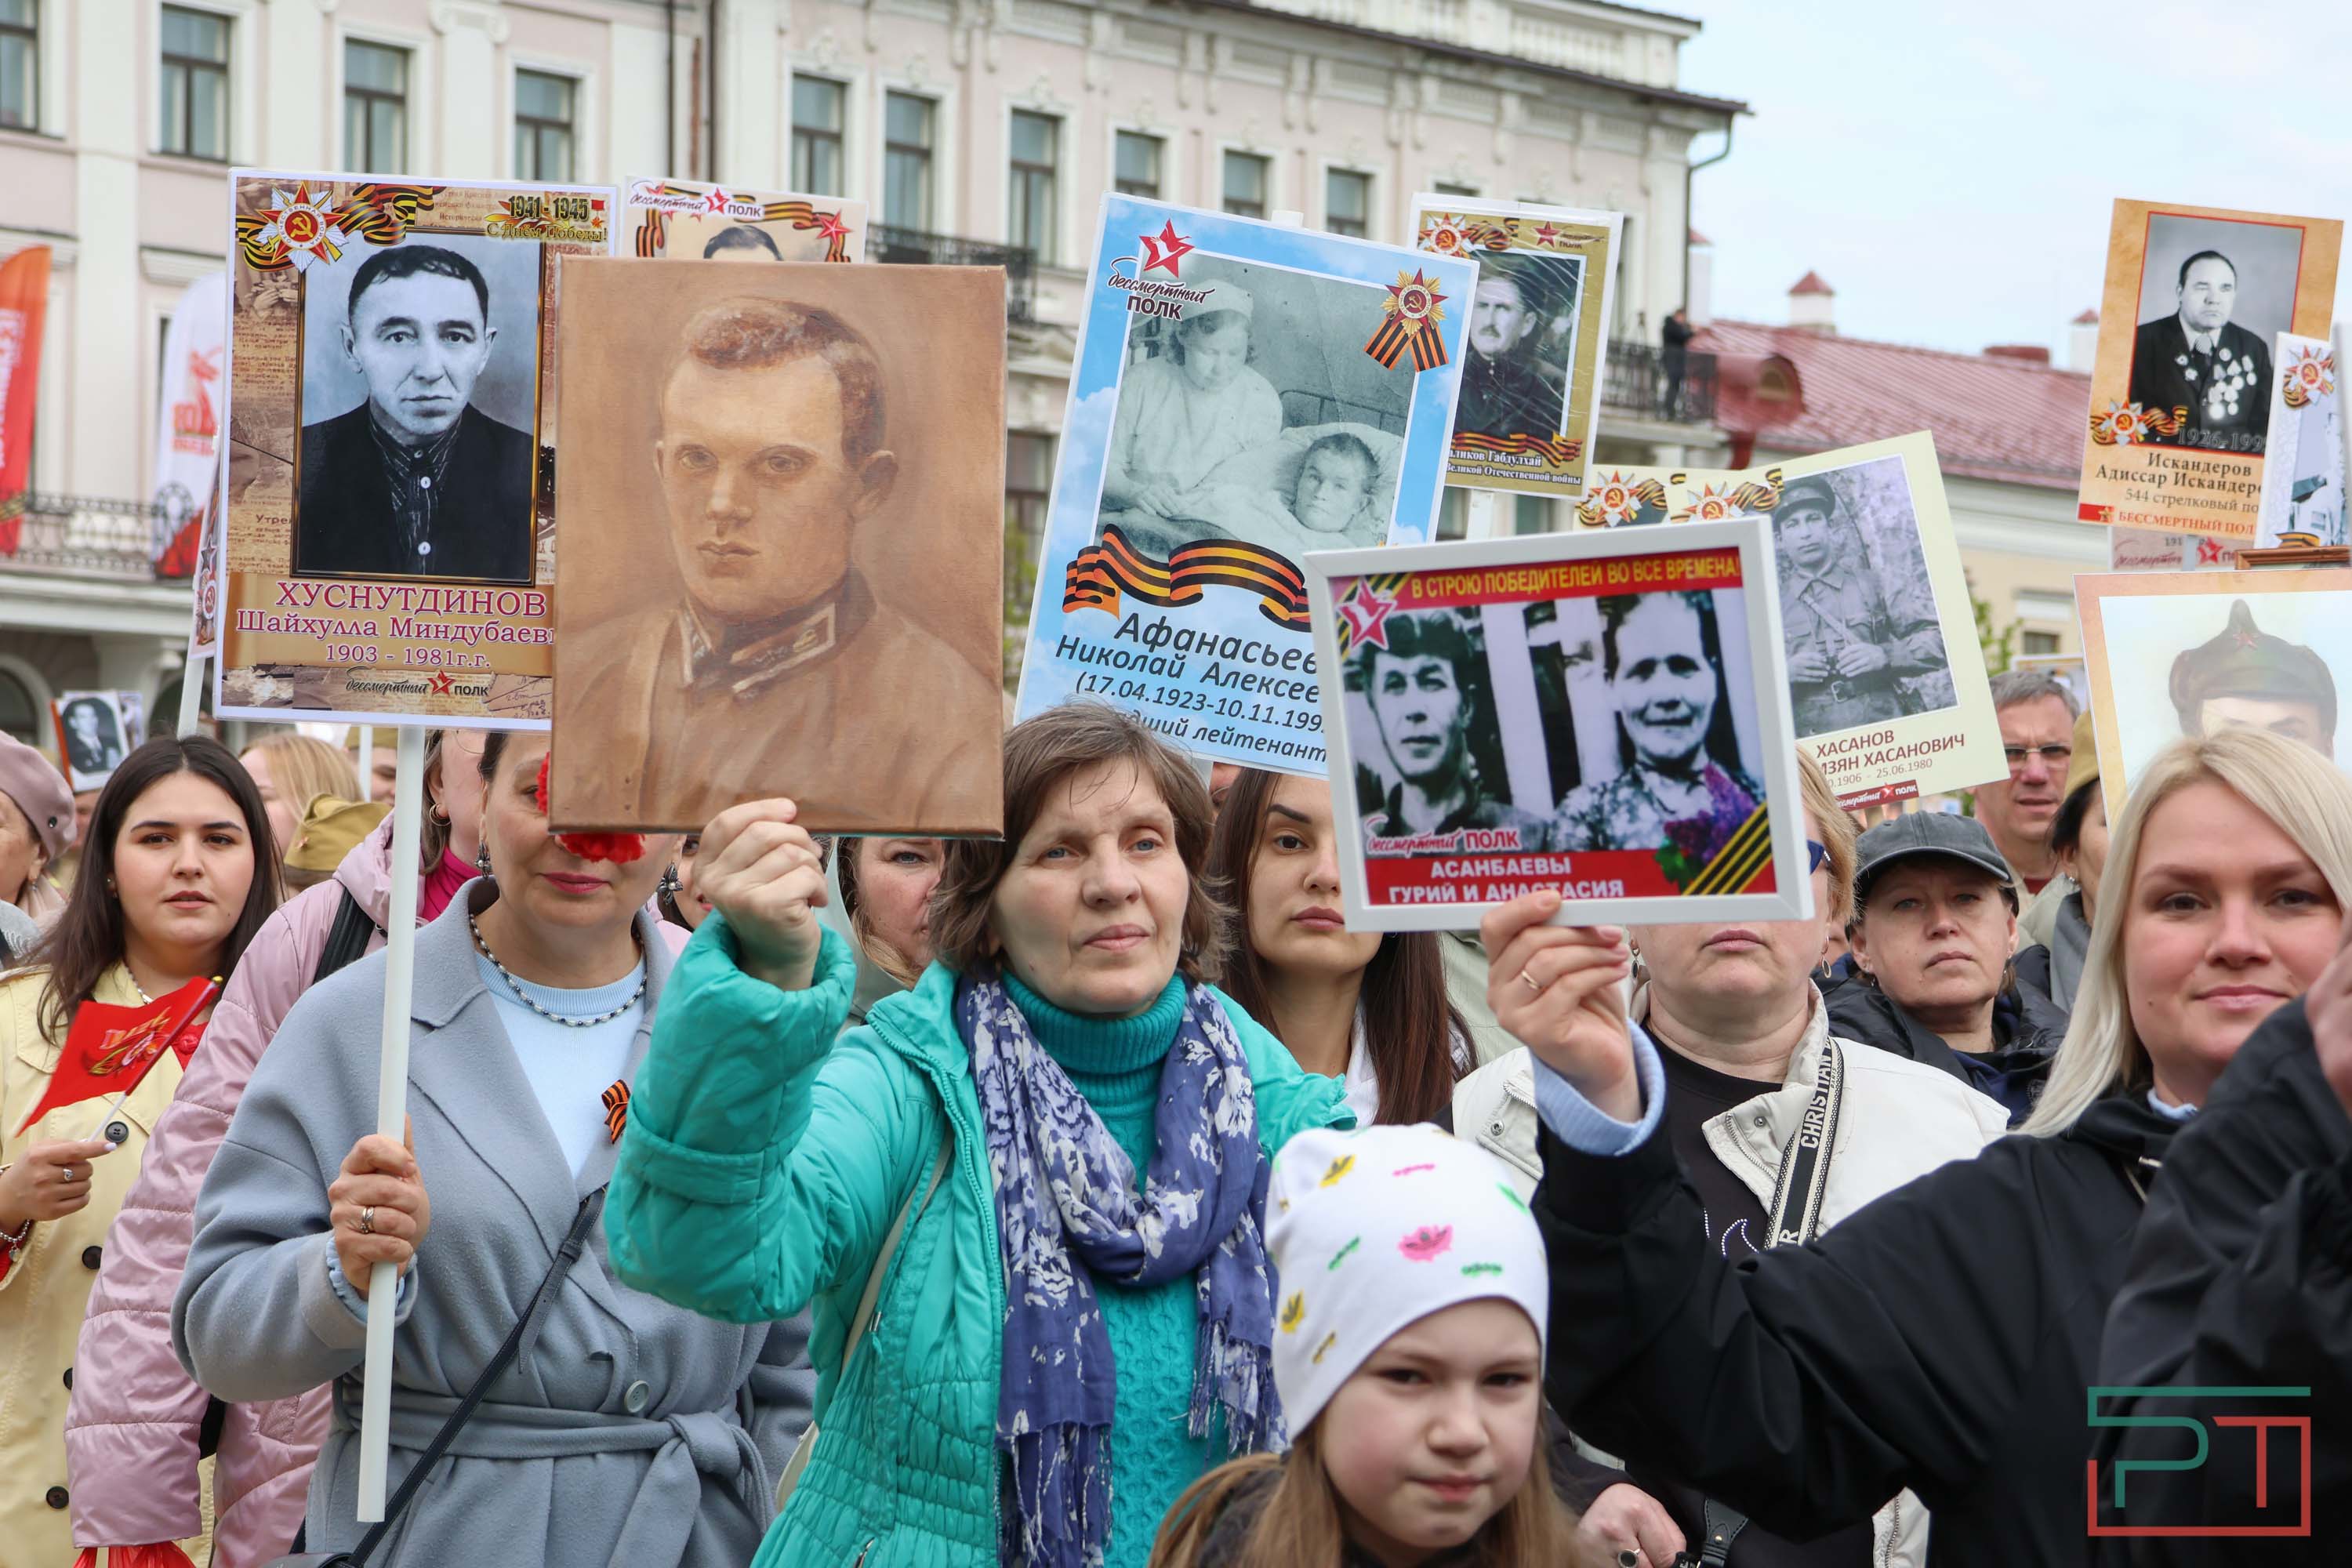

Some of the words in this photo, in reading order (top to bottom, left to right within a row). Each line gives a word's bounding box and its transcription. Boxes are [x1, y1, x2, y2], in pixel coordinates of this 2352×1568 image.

[508, 196, 541, 219] 1941
[553, 197, 589, 220] 1945
[728, 205, 761, 217] ПОЛК
[546, 225, 608, 241] Победы!
[1127, 295, 1182, 320] ПОЛК
[2179, 427, 2265, 454] 1926-199
[1488, 451, 1543, 468] Габдулхай
[2147, 452, 2252, 480] Искандеров
[1484, 466, 1551, 483] Отечественной
[1552, 474, 1582, 485] войны
[2095, 464, 2167, 488] Адиссар
[2125, 488, 2149, 503] 544
[2153, 495, 2238, 511] стрелковый
[2118, 510, 2221, 532] БЕССМЕРТНЫЙ
[2224, 521, 2255, 535] ПОЛ
[1412, 582, 1423, 599] В
[1426, 575, 1481, 597] СТРОЮ
[1485, 564, 1603, 595] ПОБЕДИТЕЛЕЙ
[1607, 564, 1629, 584] ВО
[1633, 560, 1663, 582] ВСЕ
[1666, 555, 1740, 580] ВРЕМЕНА!
[275, 582, 547, 618] ХУСНУТДИНОВ
[237, 609, 378, 641] Шайхулла
[325, 644, 378, 662] 1903
[404, 647, 491, 668] 1981г.г.
[1055, 634, 1186, 679] Николай
[454, 684, 488, 696] ПОЛК
[1075, 671, 1325, 734] (17.04.1923-10.11.199
[1816, 730, 1895, 759] ХАСАНОВ
[1864, 734, 1965, 768] ХАСАНОВИЧ
[1876, 758, 1933, 779] 25.06.1980
[1464, 830, 1520, 850] ПОЛК
[1431, 858, 1571, 879] АСАНБАЕВЫ
[1388, 885, 1457, 903] ГУРИЙ
[1463, 885, 1477, 902] И
